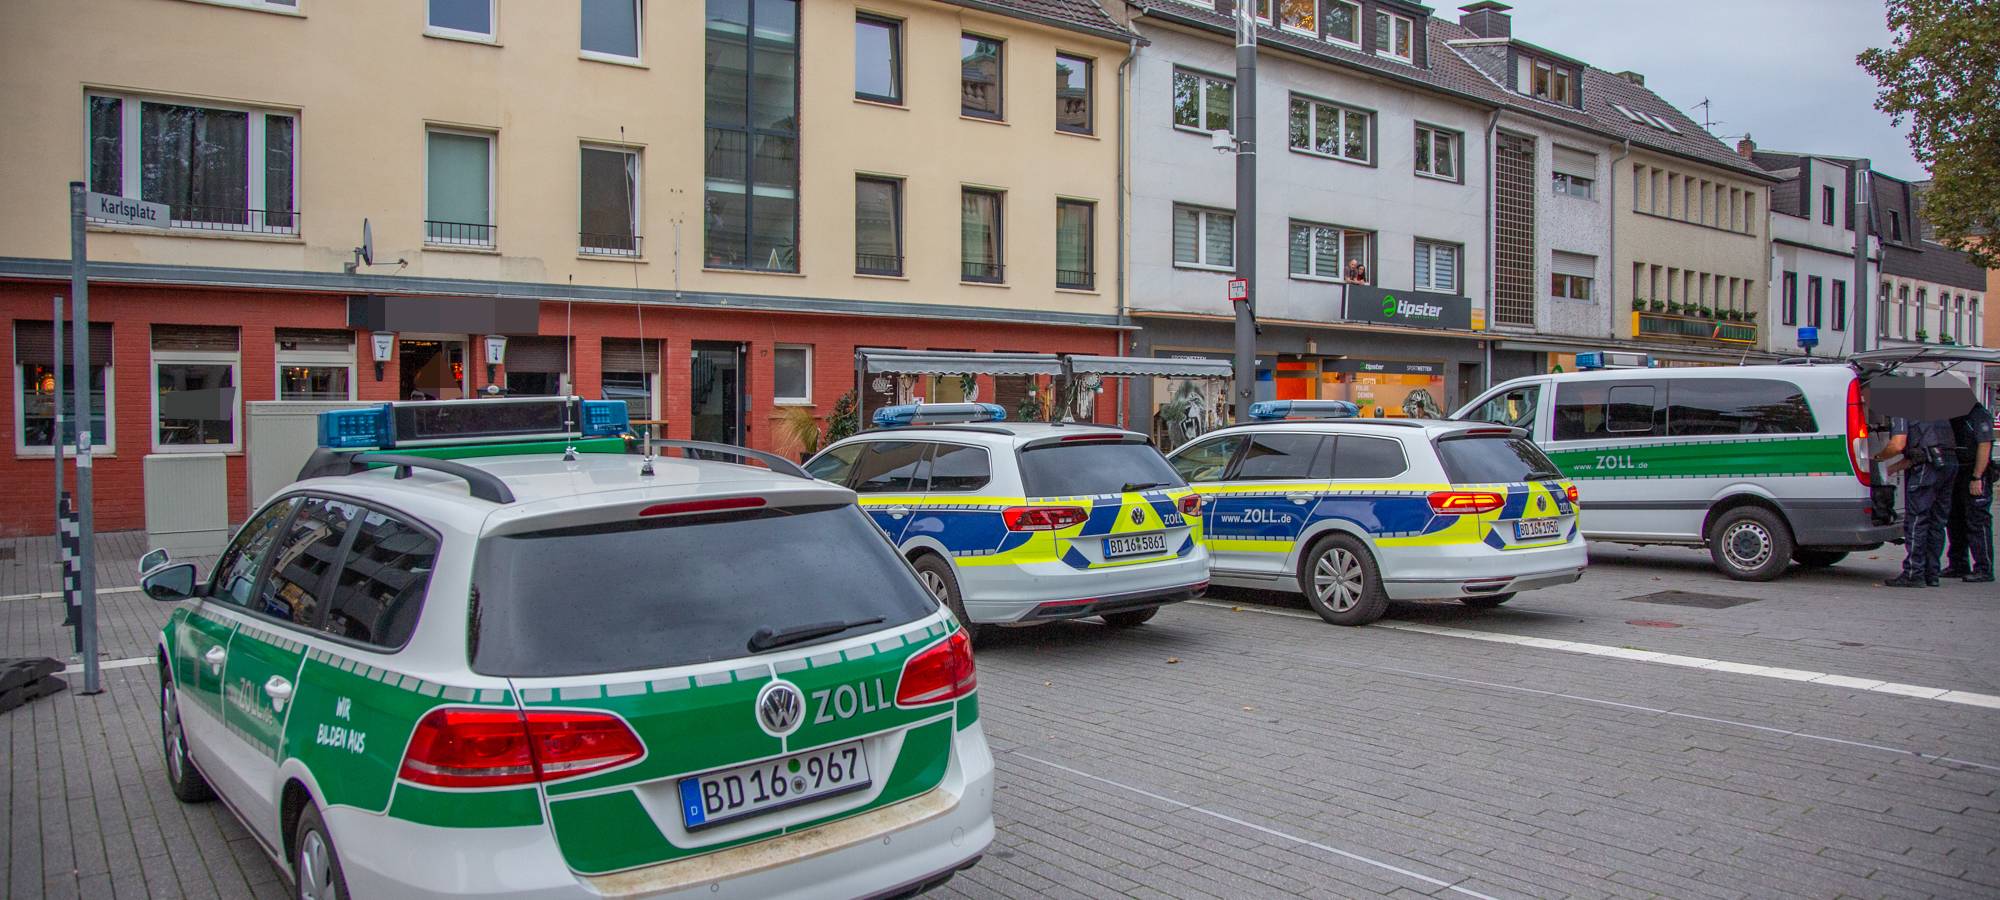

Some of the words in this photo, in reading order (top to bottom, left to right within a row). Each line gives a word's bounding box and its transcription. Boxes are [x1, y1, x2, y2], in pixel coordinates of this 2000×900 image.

[101, 197, 156, 220] Karlsplatz
[1397, 300, 1443, 317] tipster
[1163, 513, 1184, 525] ZOLL
[1221, 509, 1292, 523] www.ZOLL.de
[1142, 535, 1166, 550] 5861
[335, 696, 352, 722] WIR
[811, 678, 892, 725] ZOLL
[316, 723, 348, 749] BILDEN
[347, 729, 366, 754] AUS
[807, 748, 858, 789] 967
[690, 805, 699, 817] D
